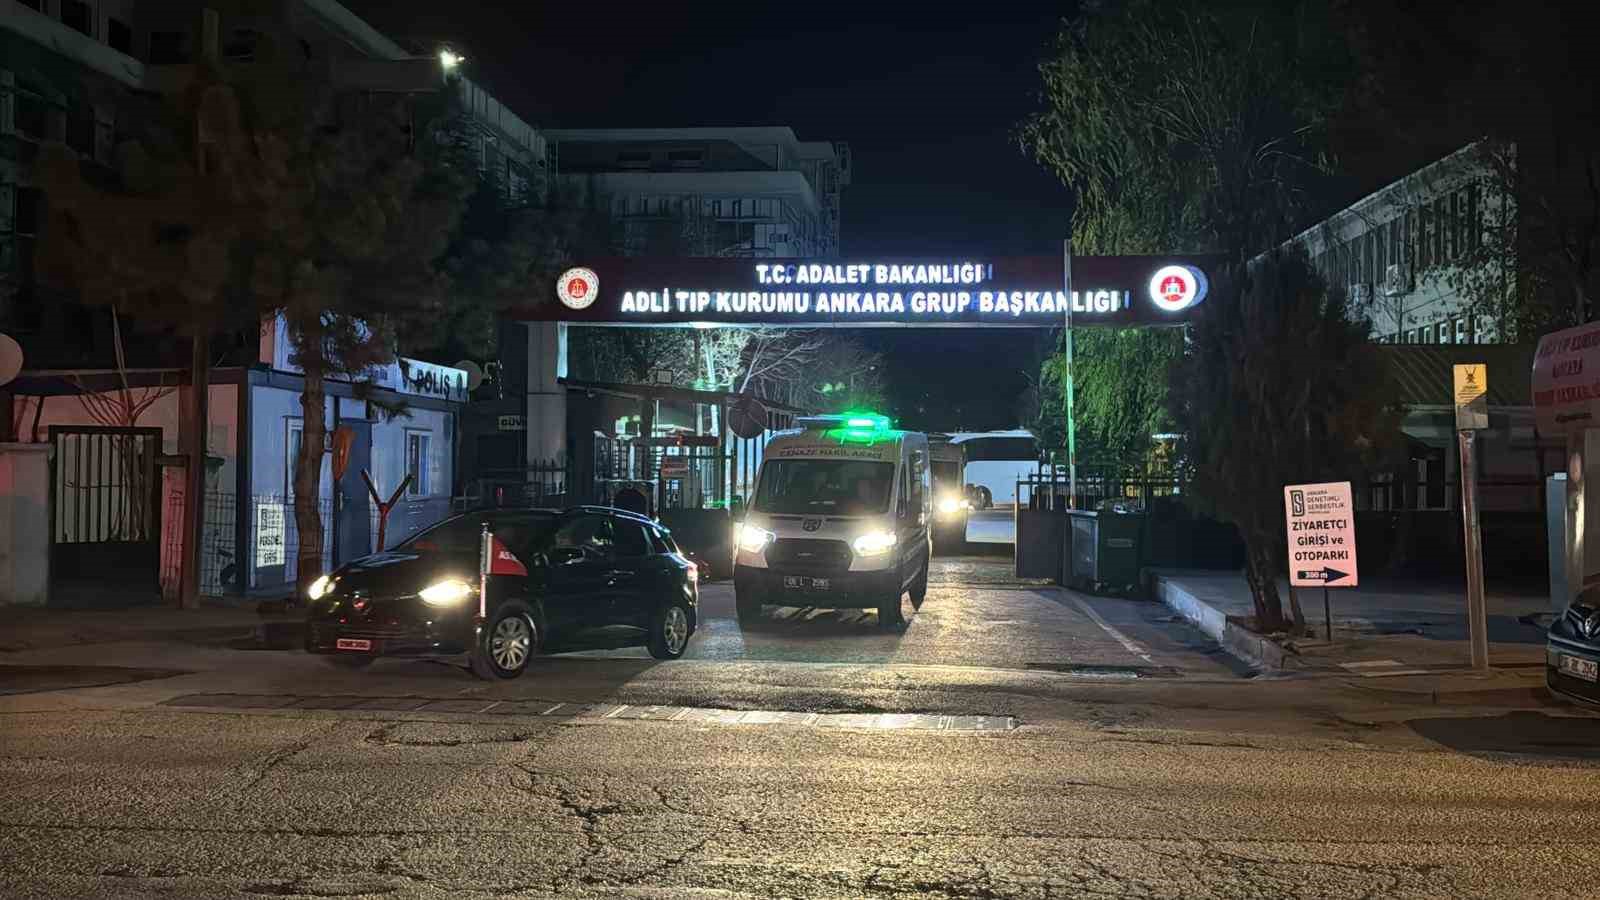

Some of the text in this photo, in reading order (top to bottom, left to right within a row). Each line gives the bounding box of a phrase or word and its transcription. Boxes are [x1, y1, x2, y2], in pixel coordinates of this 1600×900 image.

[756, 261, 983, 284] T.C. ADALET BAKANLIĞI
[620, 287, 670, 313] ADLİ
[675, 291, 710, 313] TIP
[716, 291, 810, 313] KURUMU
[816, 291, 905, 313] ANKARA
[911, 290, 971, 313] GRUP
[1330, 536, 1345, 545] ve
[1294, 550, 1349, 561] OTOPARKI
